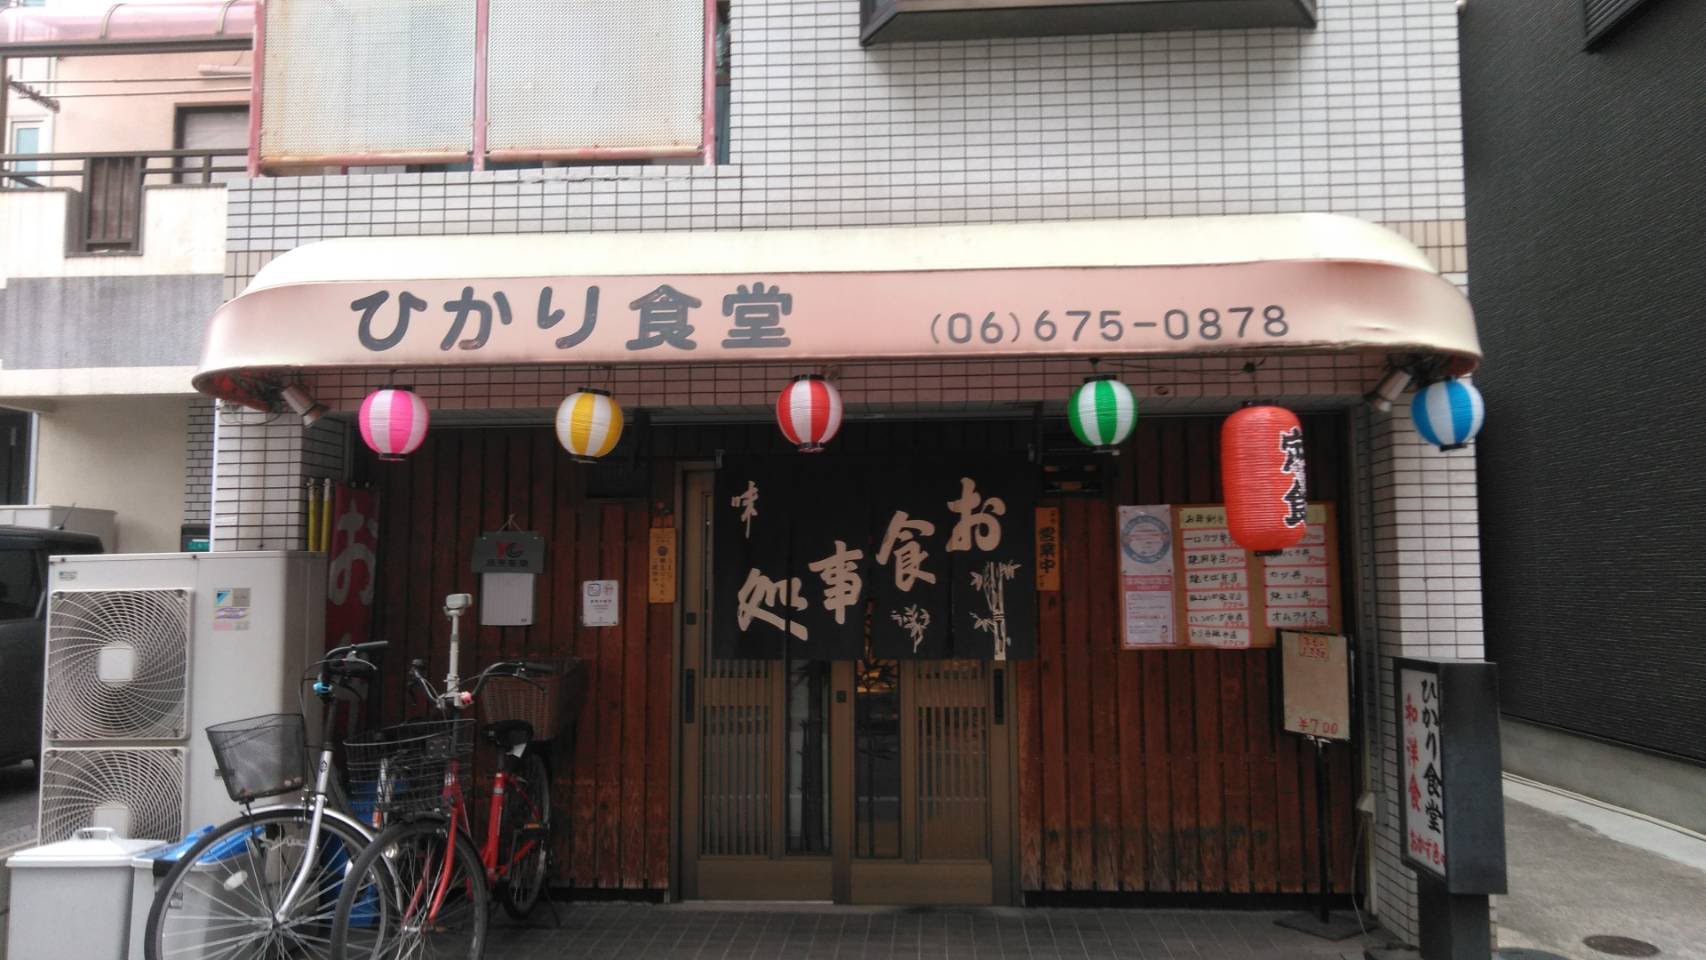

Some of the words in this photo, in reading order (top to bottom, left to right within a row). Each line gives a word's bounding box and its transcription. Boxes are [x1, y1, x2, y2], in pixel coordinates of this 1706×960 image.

[350, 281, 793, 352] ひかり食堂
[930, 304, 1290, 345] (06)675-0878
[737, 476, 1006, 641] お食事処
[1404, 692, 1422, 812] 和洋食
[1420, 679, 1444, 834] ひかり食堂
